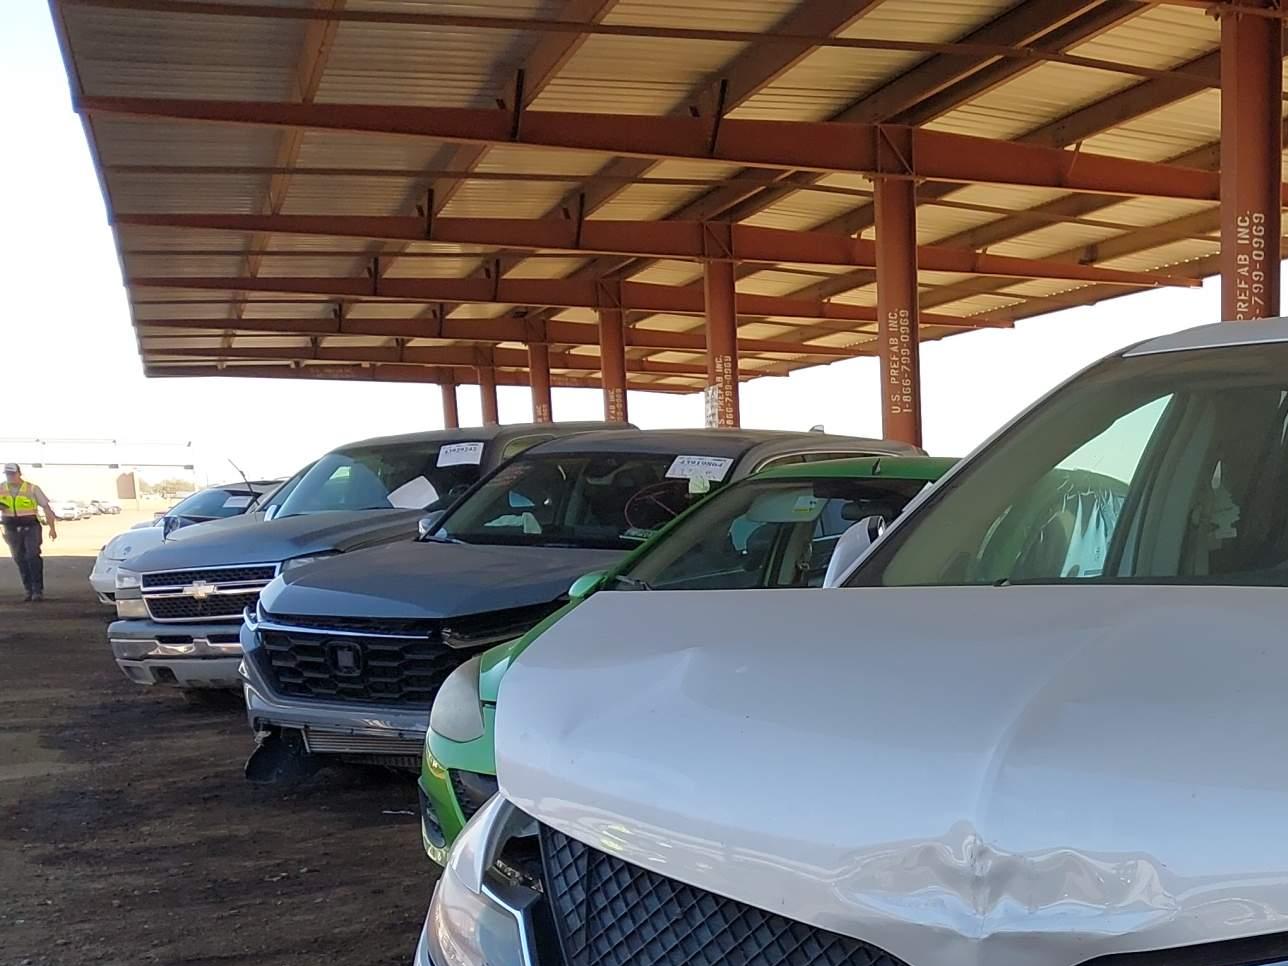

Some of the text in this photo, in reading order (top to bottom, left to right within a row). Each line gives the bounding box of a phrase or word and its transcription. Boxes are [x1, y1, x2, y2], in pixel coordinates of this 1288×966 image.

[1237, 210, 1251, 244] INC.
[888, 307, 902, 414] U.S. PREFAB INC.
[899, 309, 912, 413] 1-866-799-0969
